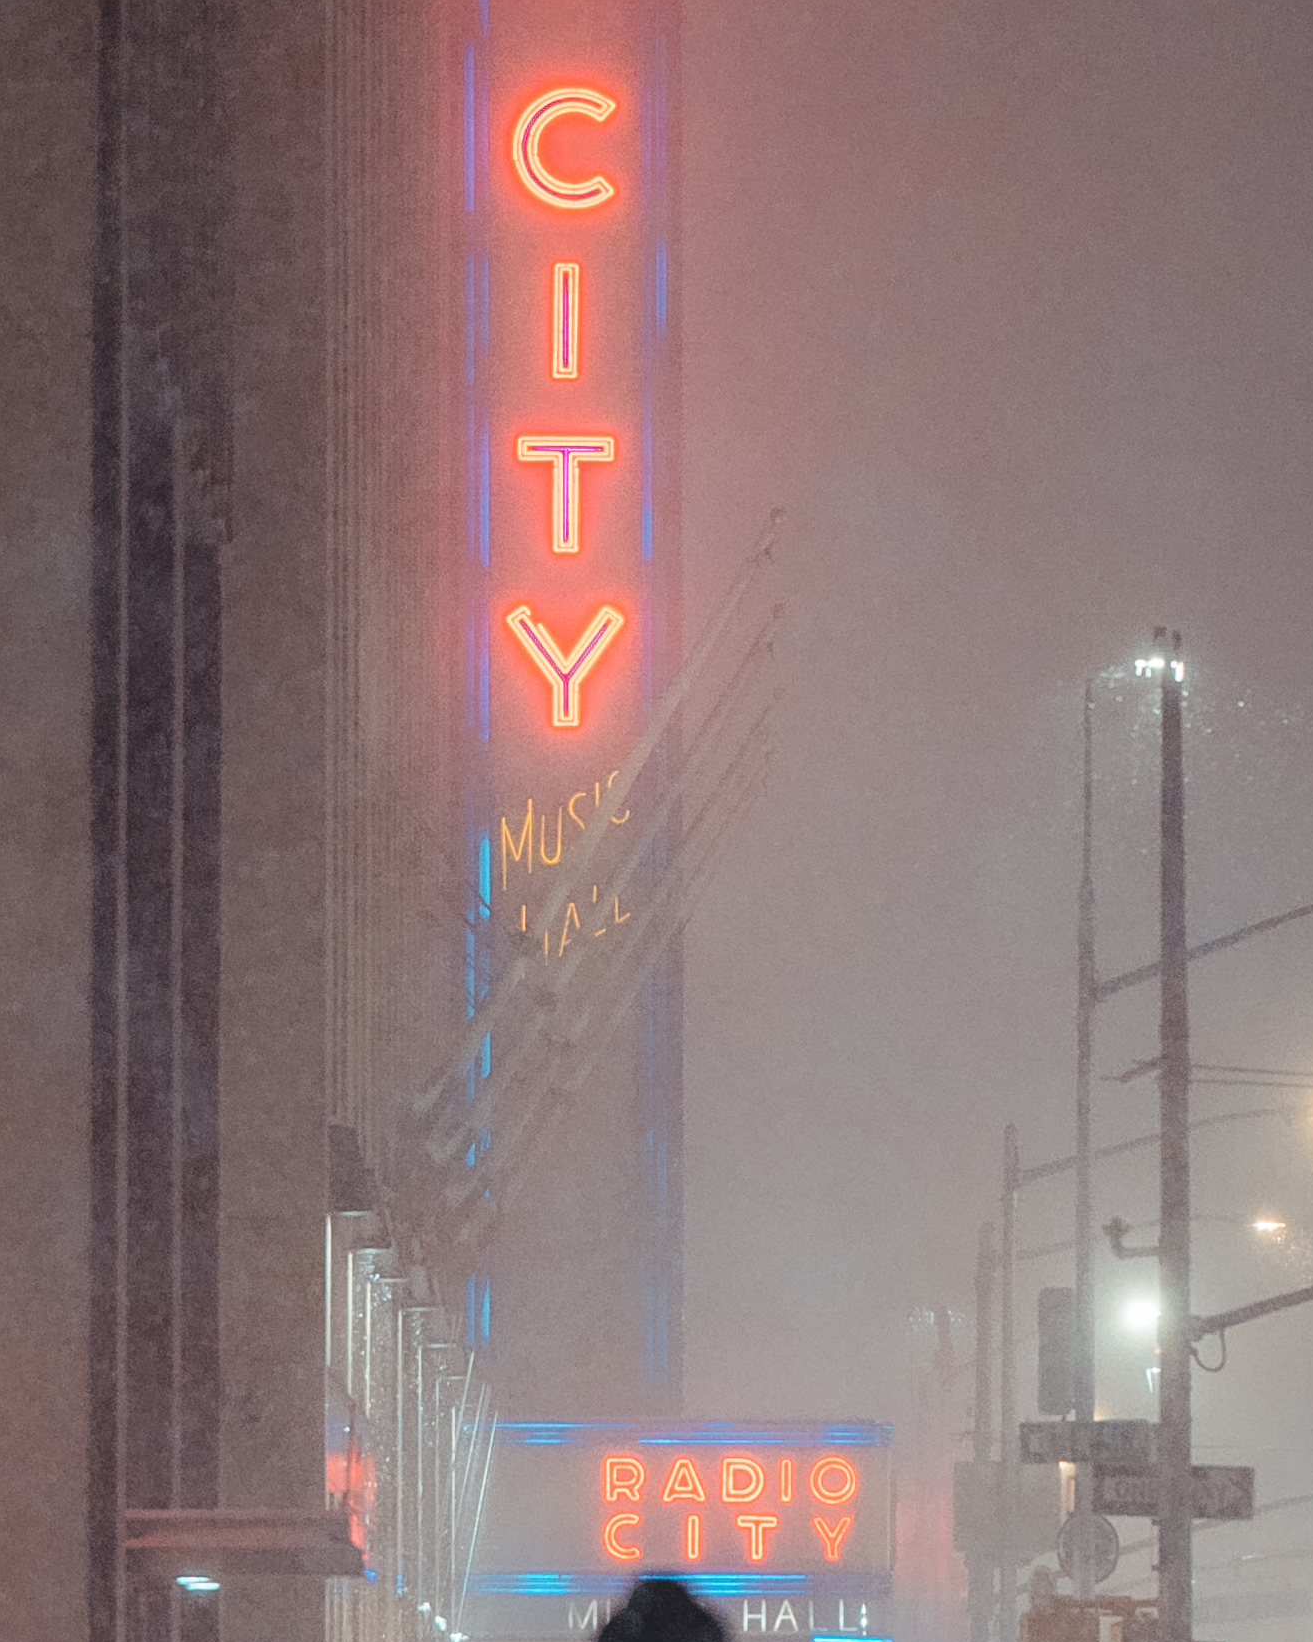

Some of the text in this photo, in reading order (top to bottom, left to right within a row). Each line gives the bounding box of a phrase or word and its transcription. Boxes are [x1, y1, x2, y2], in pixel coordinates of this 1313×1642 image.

[506, 88, 625, 727] CITY
[604, 1455, 858, 1505] RADIO
[603, 1512, 853, 1561] CITY
[742, 1598, 858, 1633] HALL
